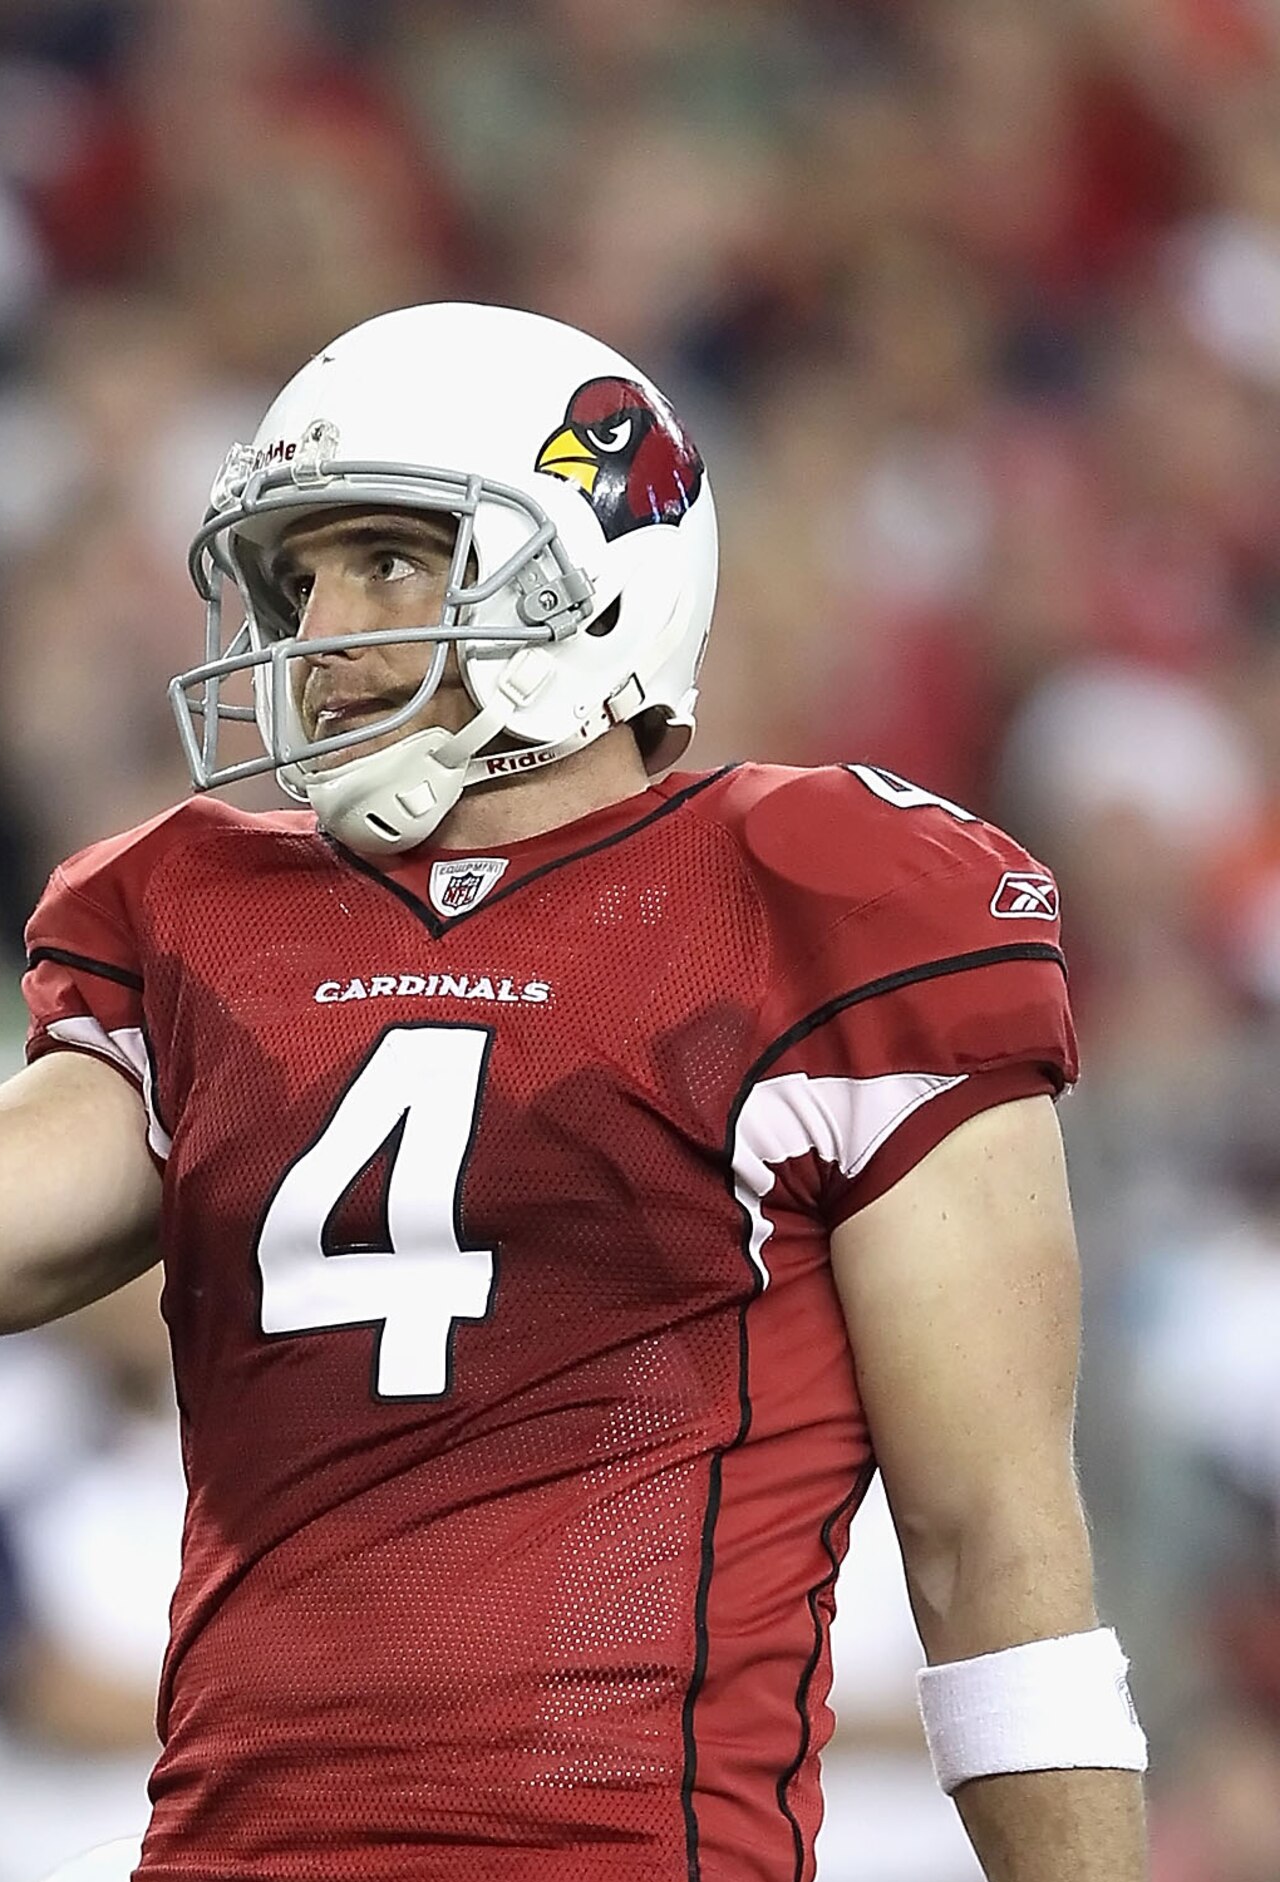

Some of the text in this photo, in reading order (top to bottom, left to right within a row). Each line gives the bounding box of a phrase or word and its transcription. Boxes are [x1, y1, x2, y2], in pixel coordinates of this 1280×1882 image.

[445, 886, 474, 905] NFL
[314, 973, 551, 1004] CARDINALS
[257, 1026, 494, 1398] 4
